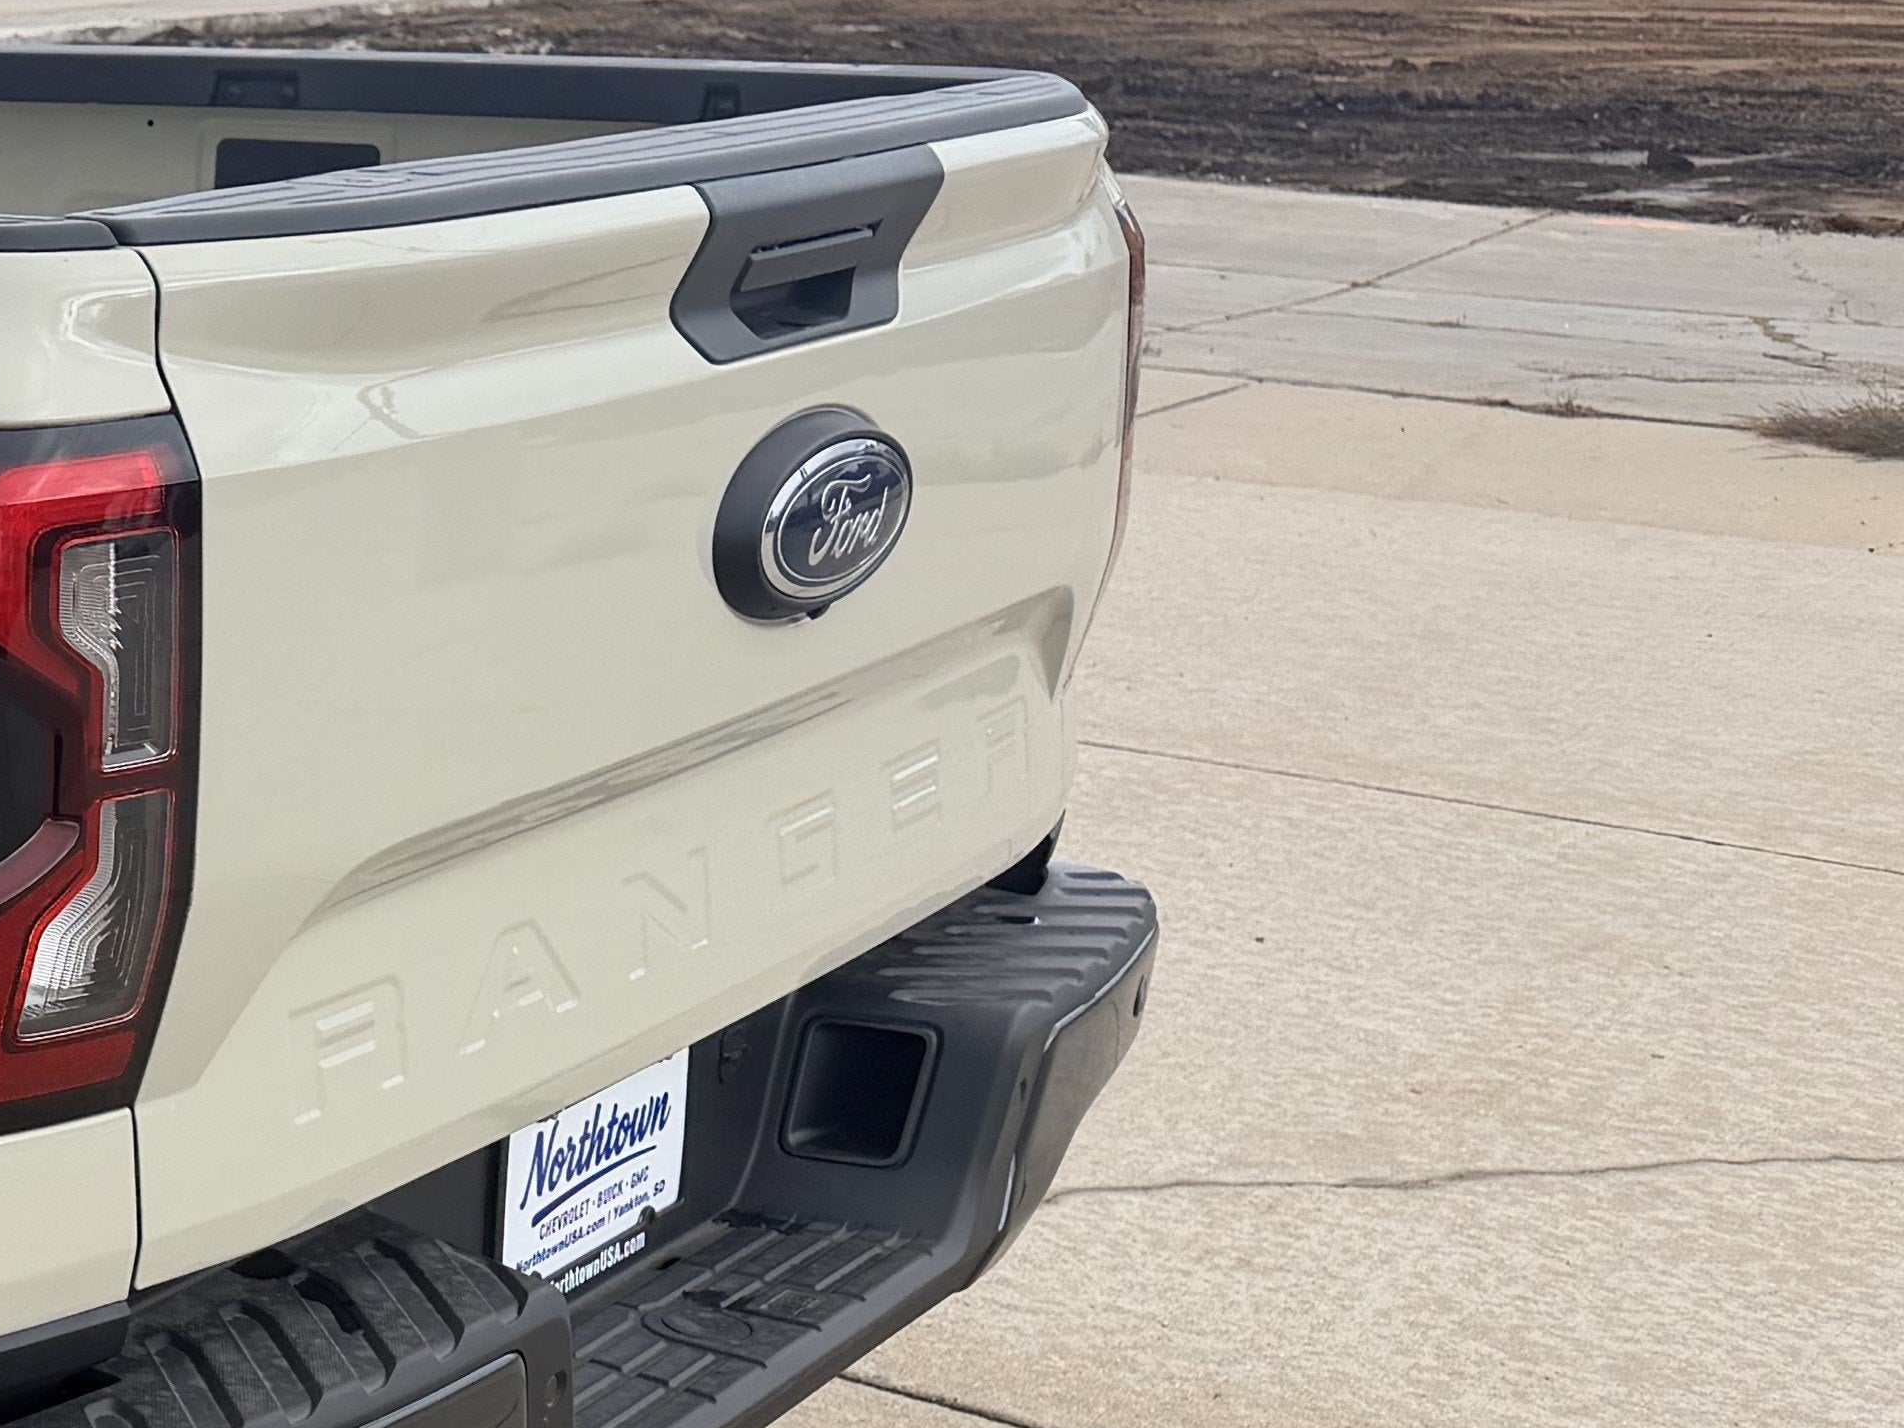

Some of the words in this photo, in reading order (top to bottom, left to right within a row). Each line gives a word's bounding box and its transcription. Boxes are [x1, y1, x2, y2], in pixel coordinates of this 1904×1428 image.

[808, 473, 889, 566] Ford
[292, 695, 1030, 1125] RANGER
[519, 1092, 672, 1210] Northtown
[516, 1216, 606, 1272] NorthtownUSA.com
[653, 1178, 666, 1197] SD
[539, 1197, 590, 1241] CHEVROLET
[597, 1179, 624, 1209] BUICK
